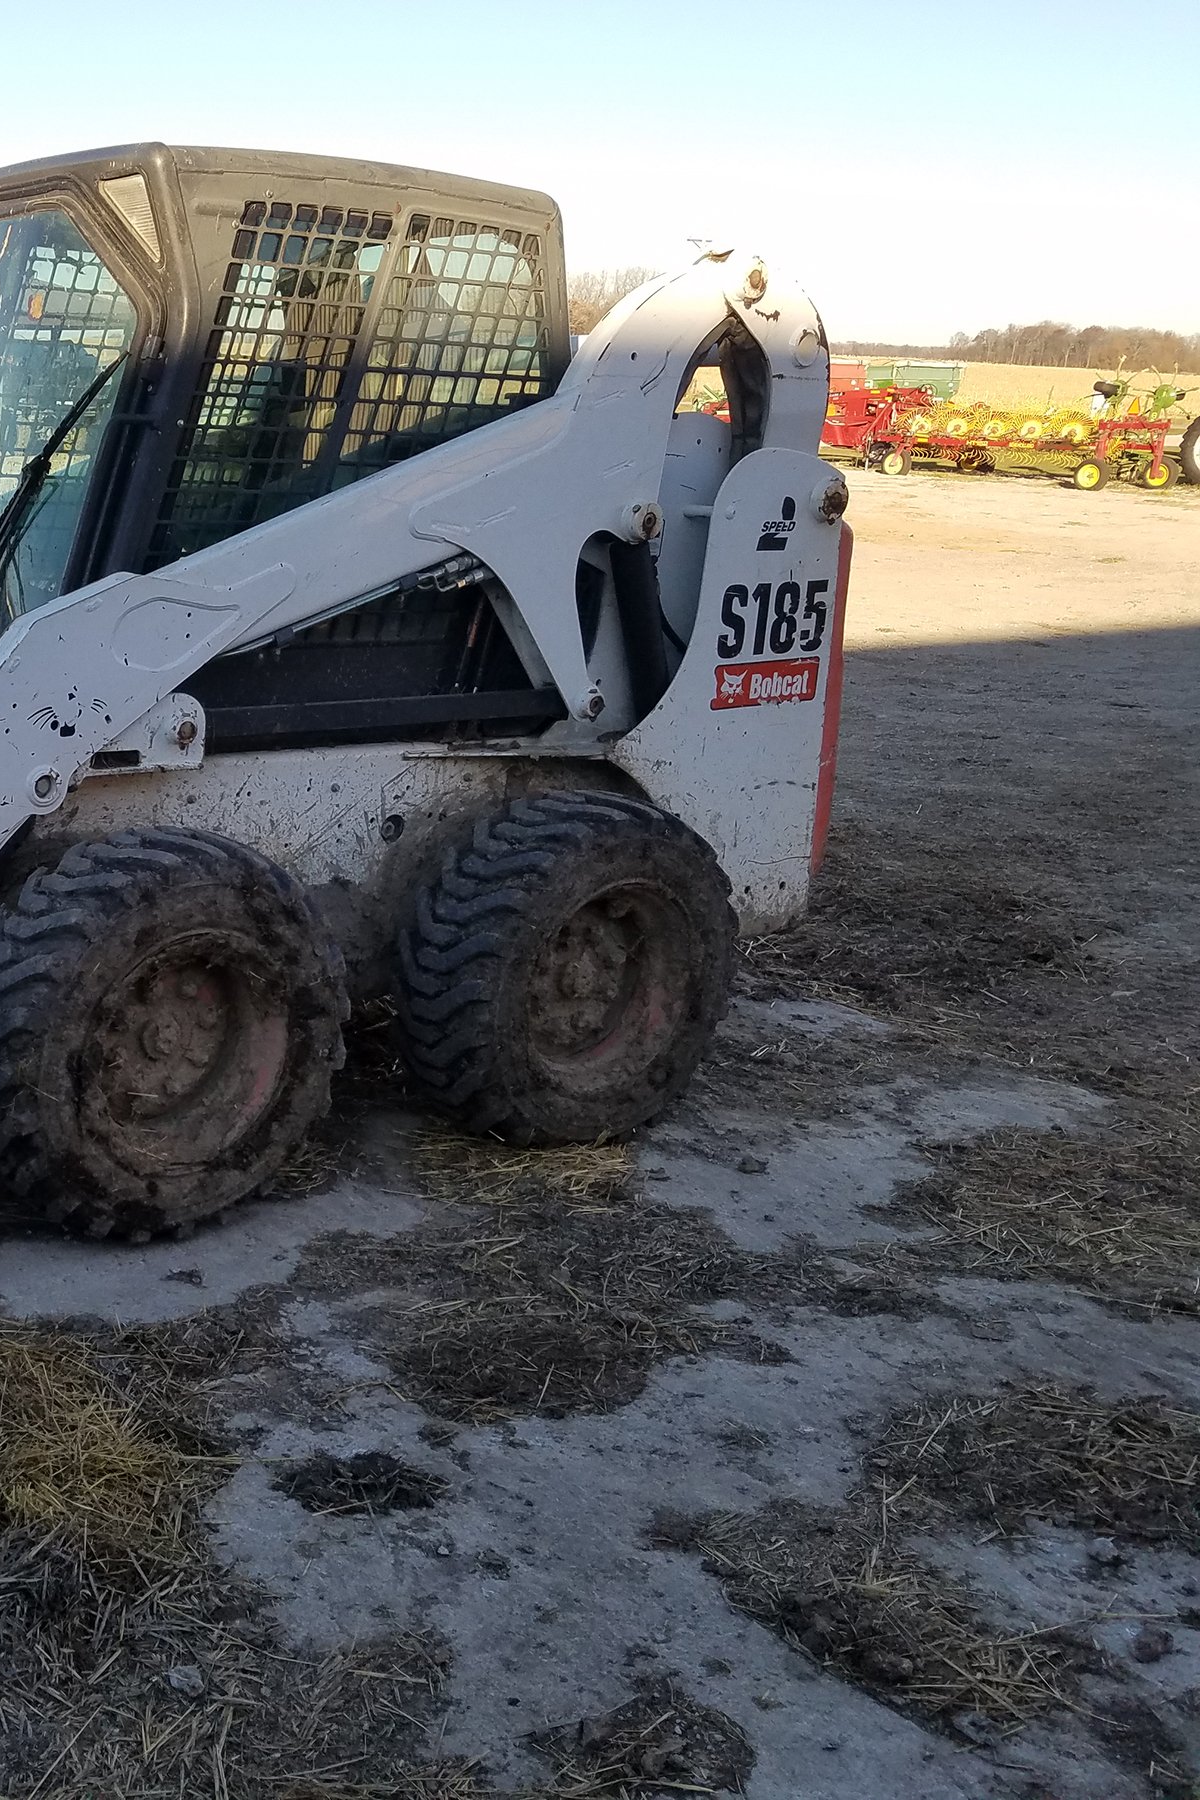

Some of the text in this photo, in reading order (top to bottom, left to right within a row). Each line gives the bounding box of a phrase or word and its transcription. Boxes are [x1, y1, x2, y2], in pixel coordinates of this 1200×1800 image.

[761, 520, 796, 532] SPEED
[717, 579, 829, 659] S185
[749, 670, 809, 699] Bobcat
